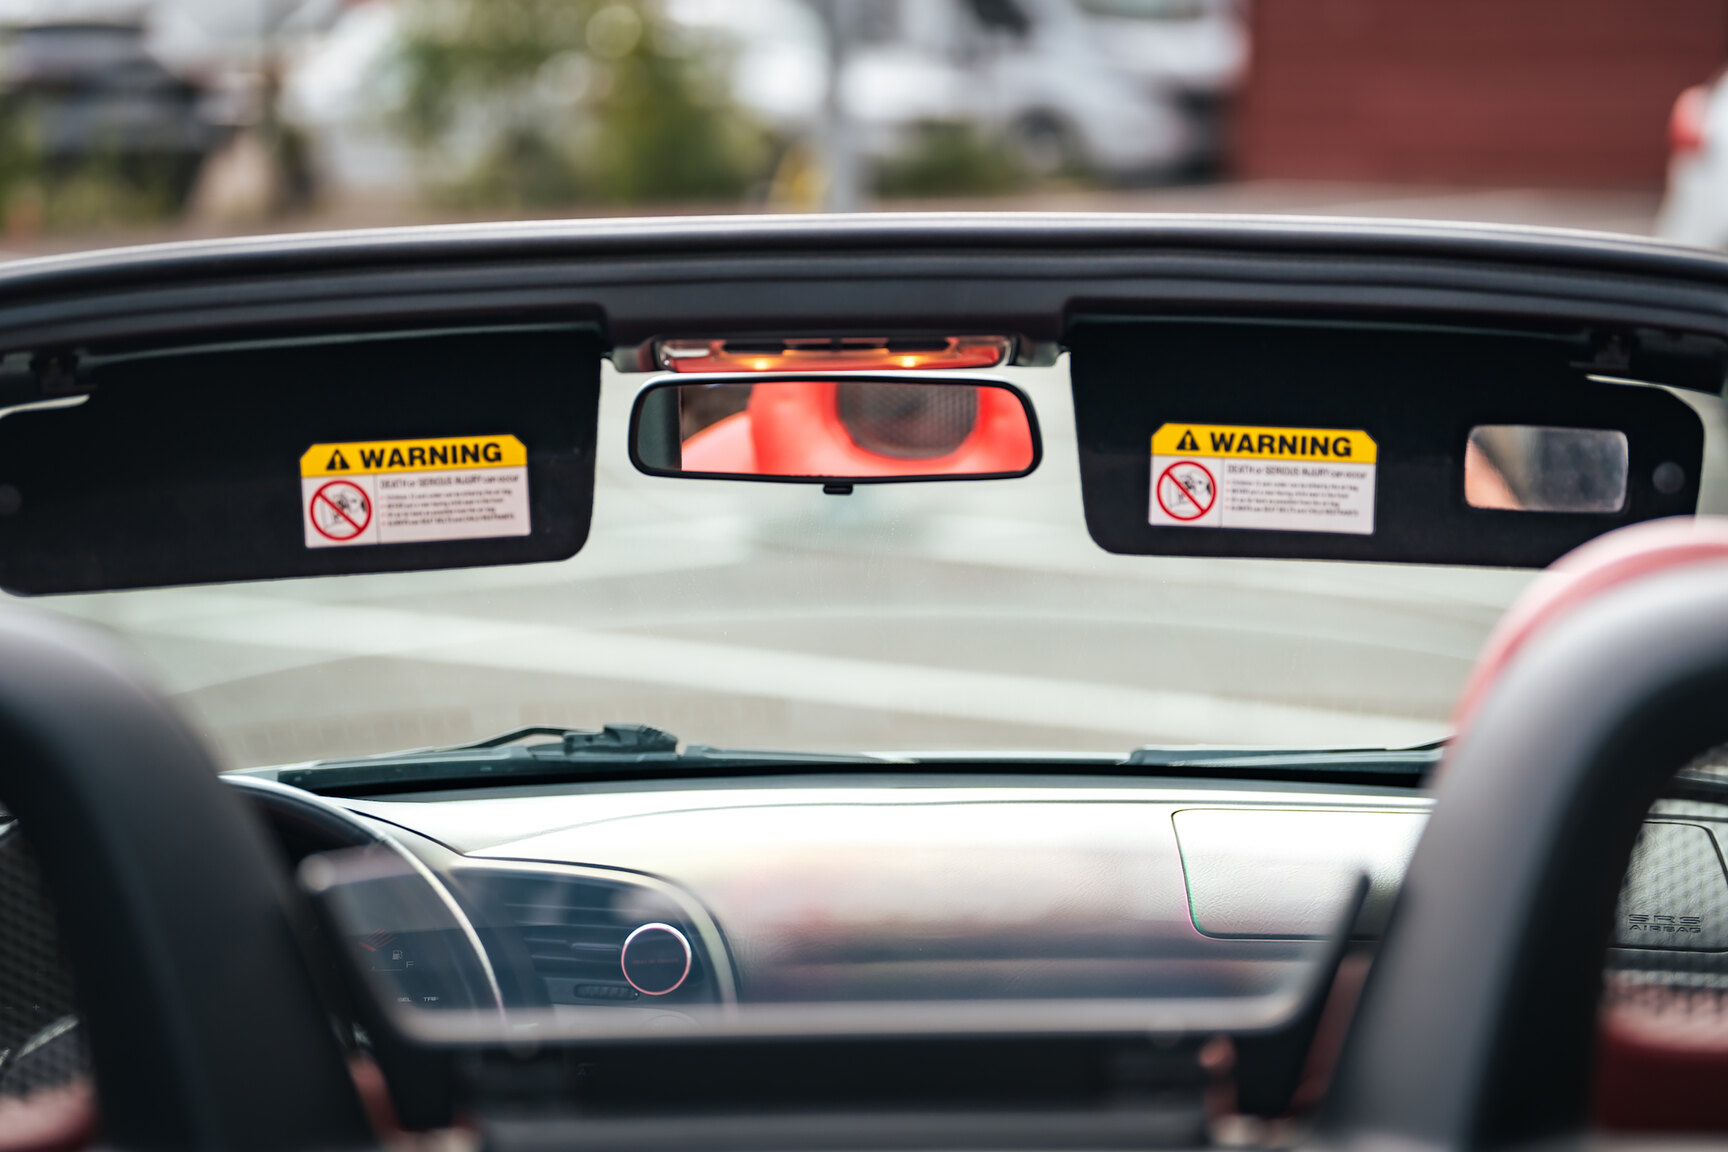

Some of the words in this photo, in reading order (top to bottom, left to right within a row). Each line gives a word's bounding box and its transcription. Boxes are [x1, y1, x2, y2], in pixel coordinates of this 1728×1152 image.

[1210, 431, 1352, 457] WARNING
[360, 442, 502, 468] WARNING
[1628, 914, 1701, 924] SRS
[1629, 924, 1701, 934] AIRBAG
